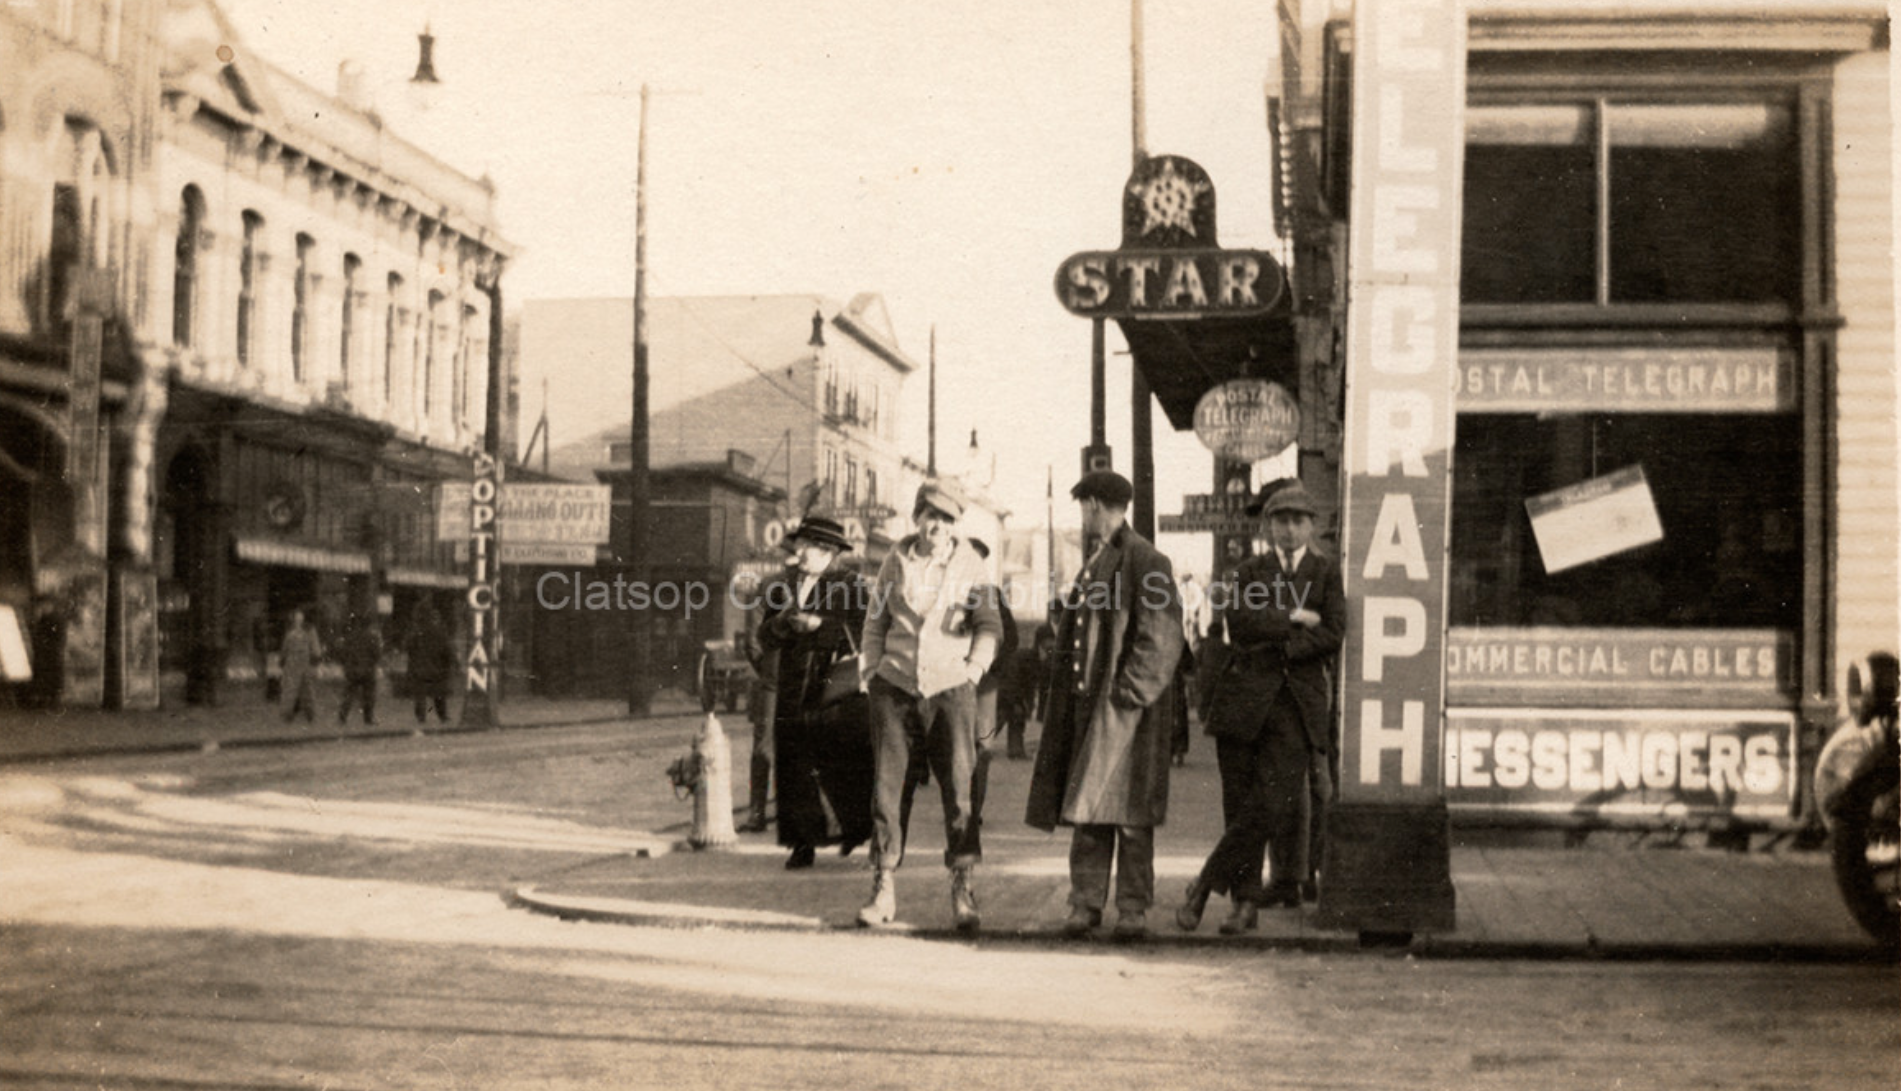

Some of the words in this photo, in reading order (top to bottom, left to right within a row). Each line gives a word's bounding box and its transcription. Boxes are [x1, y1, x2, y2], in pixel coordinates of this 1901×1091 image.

[1067, 255, 1261, 308] STAR
[1583, 364, 1778, 396] TELEGRAPH
[1204, 405, 1292, 427] TELEGRAPH
[467, 479, 495, 690] OPTICIAN
[1650, 647, 1775, 676] CABLES
